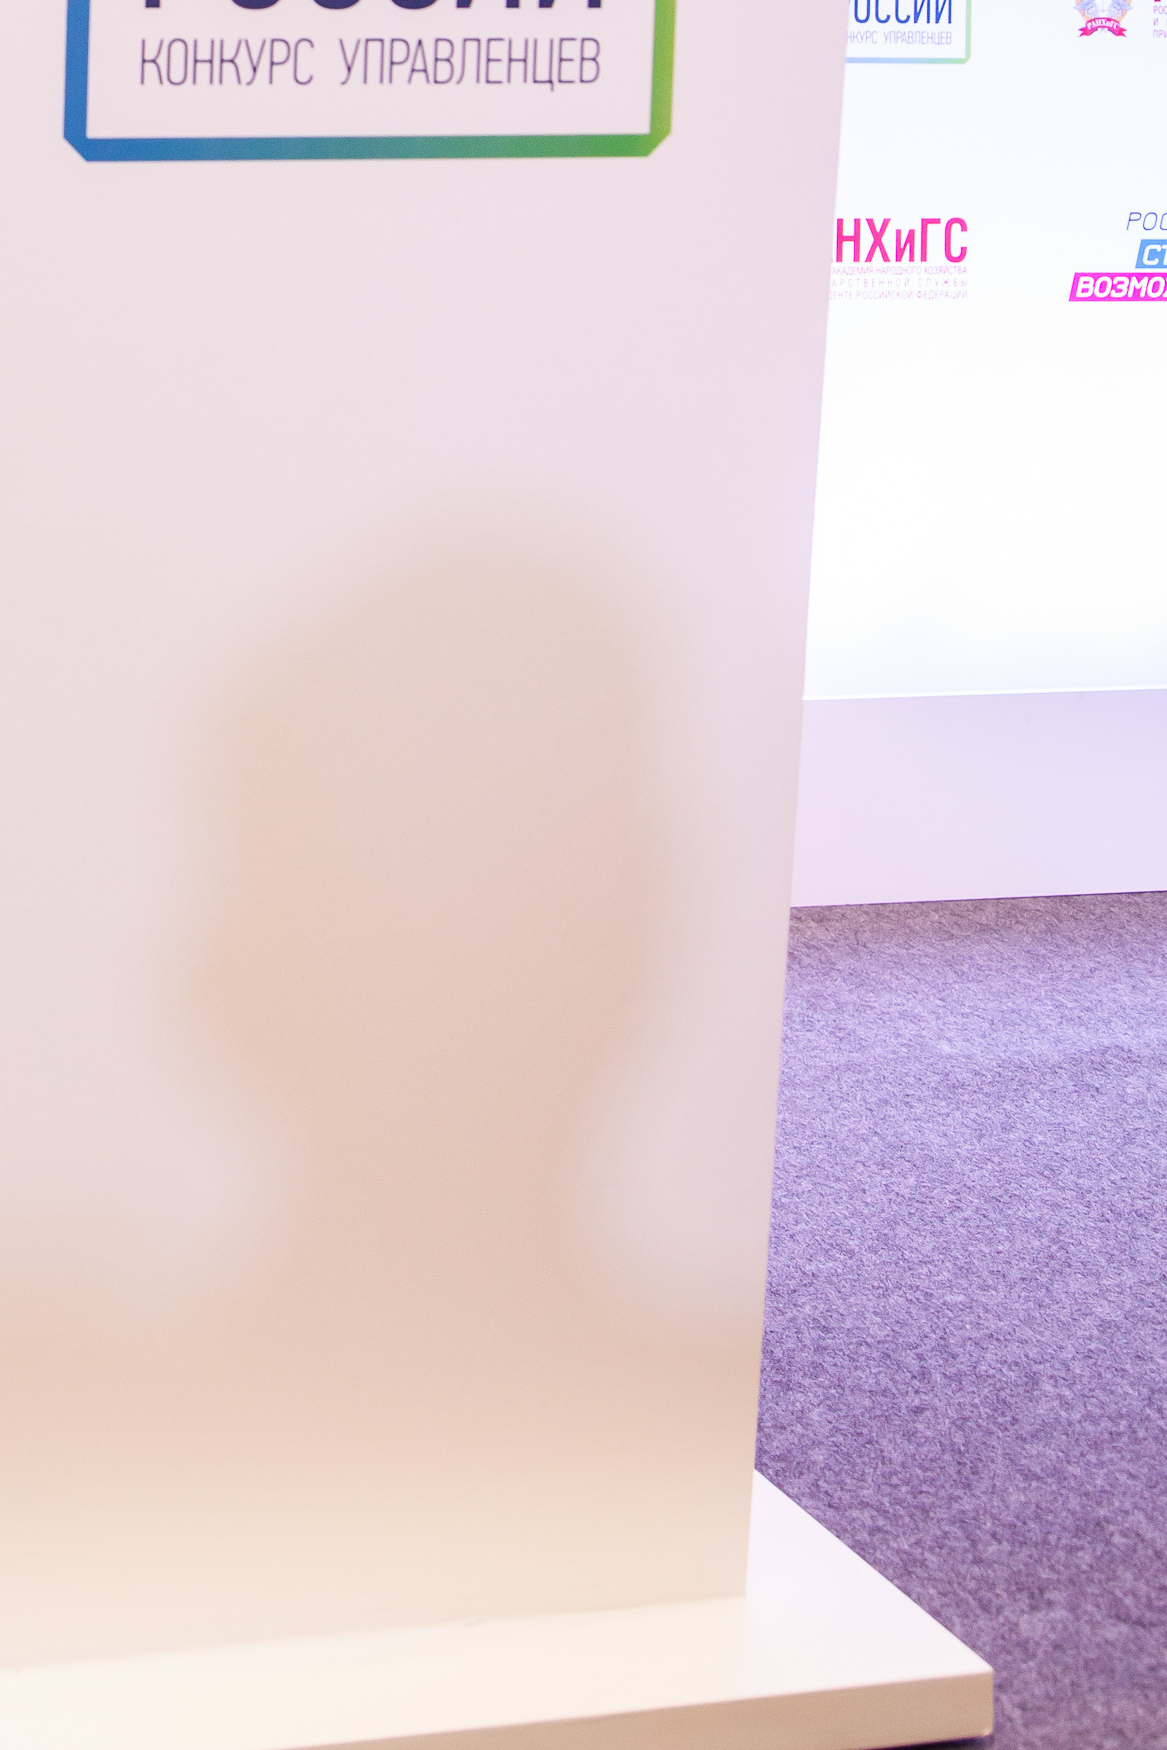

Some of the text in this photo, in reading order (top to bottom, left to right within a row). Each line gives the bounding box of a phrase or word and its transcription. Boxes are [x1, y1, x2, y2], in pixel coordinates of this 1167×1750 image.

[140, 38, 601, 92] КОНКУРС УПРАВЛЕНЦЕВ
[835, 217, 968, 263] НХиГС
